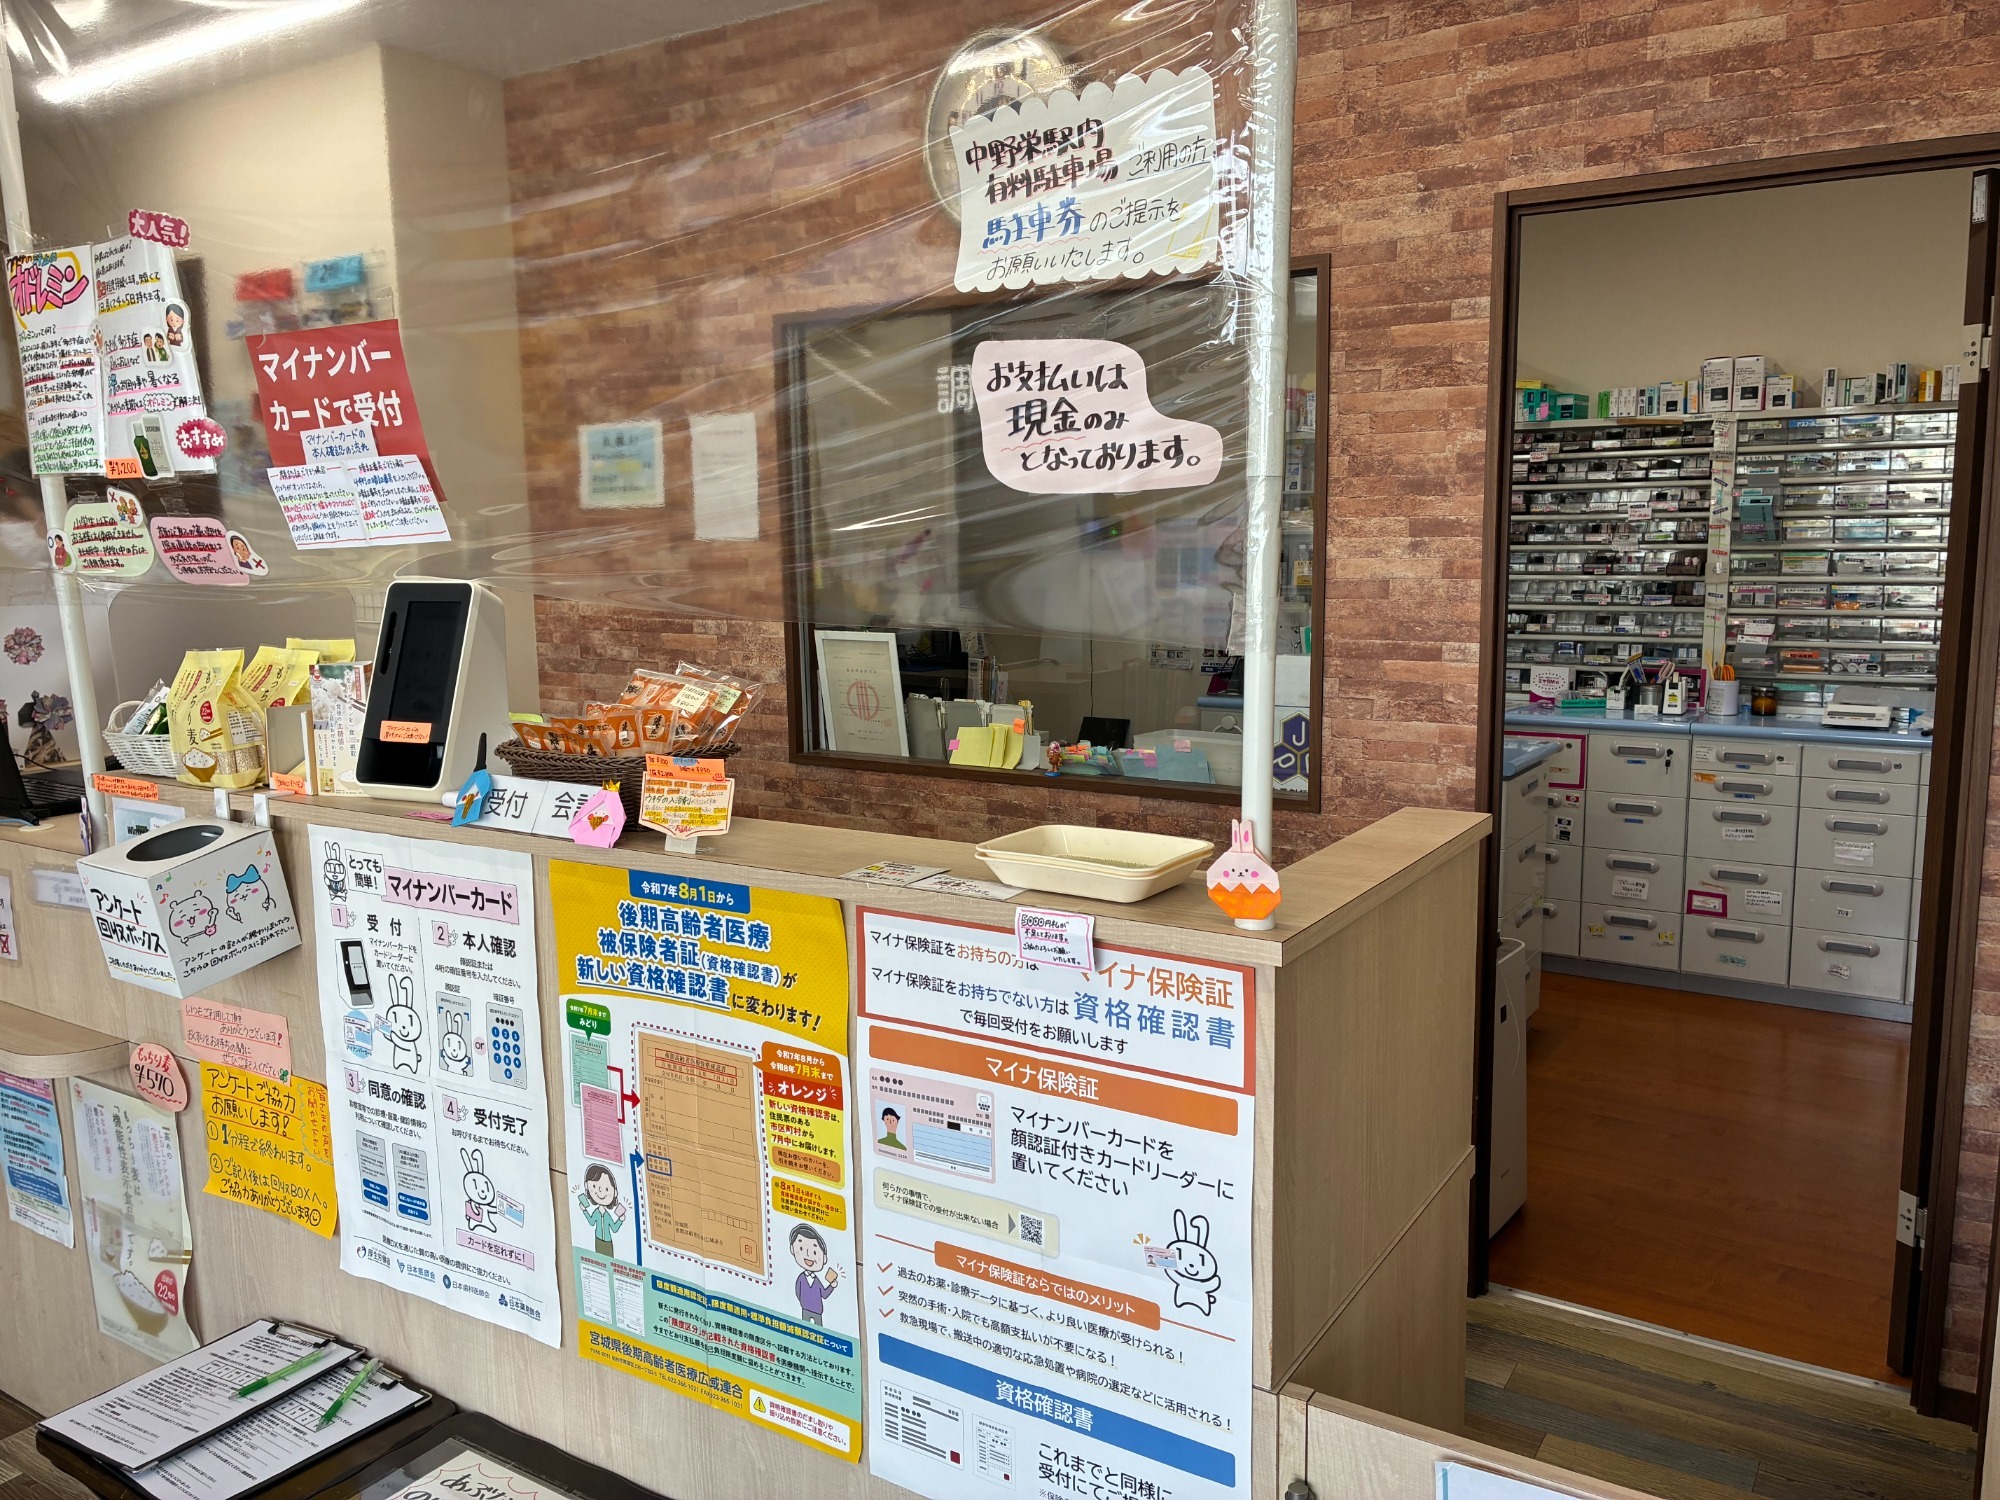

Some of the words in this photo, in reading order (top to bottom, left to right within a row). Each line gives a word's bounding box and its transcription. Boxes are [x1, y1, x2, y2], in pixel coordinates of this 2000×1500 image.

[965, 118, 1104, 174] 中野栄駅内
[985, 149, 1118, 205] 有料駐車場
[131, 212, 188, 245] 大人気！
[986, 238, 1144, 281] お願いいたします。
[9, 264, 89, 316] オドレミン
[258, 338, 392, 383] マイナンバー
[986, 361, 1128, 393] お支払いは
[269, 389, 403, 432] カードで受付
[1005, 397, 1129, 442] 現金のみ
[178, 426, 224, 449] おすすめ
[306, 428, 366, 446] マイナンバーカードの
[1020, 435, 1201, 471] となっております。
[109, 461, 137, 475] ¥1,200
[186, 670, 211, 746] もっちり麦
[1292, 720, 1306, 746] J
[484, 788, 529, 820] 受付
[349, 855, 382, 873] とっても
[354, 872, 379, 890] 簡単！
[387, 875, 512, 916] マイナンバーカード
[641, 881, 734, 906] 令和7年8月1日から
[90, 888, 142, 925] アンケート
[336, 908, 342, 923] 1
[1021, 914, 1069, 929] 5000円札が
[96, 916, 167, 955] 回収ボックス
[437, 926, 445, 941] 2
[462, 931, 517, 959] 本人確認
[618, 901, 770, 951] 後期高齢者医療
[369, 937, 417, 954] マイナンバーカードを
[374, 949, 414, 964] カードリーダーに
[576, 955, 822, 1032] 新しい資格確認書に変わります！
[1081, 960, 1235, 1010] イナ保険証
[579, 1017, 598, 1029] みどり
[870, 966, 1070, 1017] マイナ保険証をお持ちでない方は
[1073, 991, 1236, 1050] 資格確認書
[220, 1023, 283, 1047] ありがとうございます！
[475, 1041, 485, 1050] or
[959, 1007, 1129, 1055] で毎回受付をお願いします
[137, 1047, 171, 1075] もっちり麦
[770, 1060, 834, 1081] 令和8年7月末まで
[776, 1049, 825, 1066] 令和7年8月から
[134, 1063, 175, 1098] ¥570
[348, 1073, 354, 1087] 3
[368, 1080, 427, 1110] 同意の確認
[777, 1081, 827, 1103] オレンジ
[985, 1056, 1100, 1100] マイナ保険証
[211, 1098, 290, 1138] お願いします！
[355, 1111, 422, 1139] 利用について確認してください。
[447, 1102, 454, 1115] 4
[473, 1108, 528, 1137] 受付完了
[769, 1099, 841, 1123] 新しい資格確認書は、
[769, 1111, 811, 1127] 住民票のある
[451, 1128, 530, 1157] お呼びするまでお待ちください。
[770, 1122, 815, 1139] 市区町村から
[771, 1133, 837, 1158] 7月中にお届けします。
[1010, 1106, 1175, 1161] マイナンバーカードを
[778, 1159, 835, 1179] 引き続きお使いください。
[1010, 1128, 1235, 1201] 顔認証付きカードリーダーに
[1010, 1151, 1130, 1197] 置いてください
[882, 1181, 932, 1202] 何らかの事情で、
[882, 1191, 999, 1230] マイナ保険証での受付が出来ない場合
[467, 1236, 525, 1263] カードを忘れずに！
[744, 1244, 753, 1256] 印
[406, 1264, 436, 1281] 日本医師会
[955, 1253, 1135, 1316] マイナ保険証ならではのメリット
[509, 1299, 541, 1319] 日本薬剤師会
[897, 1266, 1184, 1363] 過去のお薬・診療データに基づく、より良い医療が受けられる！
[898, 1290, 1115, 1367] 突然の手術・入院でも高額支払いが不要になる！
[589, 1331, 744, 1400] 宮城県後期高齢者医療広域連合
[899, 1312, 1232, 1431] 救急現場で、搬送中の適切な応急処置や病院の選定などに活用される！
[769, 1401, 833, 1430] 資格確認書のだまし取りや
[995, 1379, 1094, 1432] 資格確認書
[769, 1409, 847, 1446] 振り込め詐欺にご注意ください。
[1038, 1441, 1173, 1500] これまでと同様に
